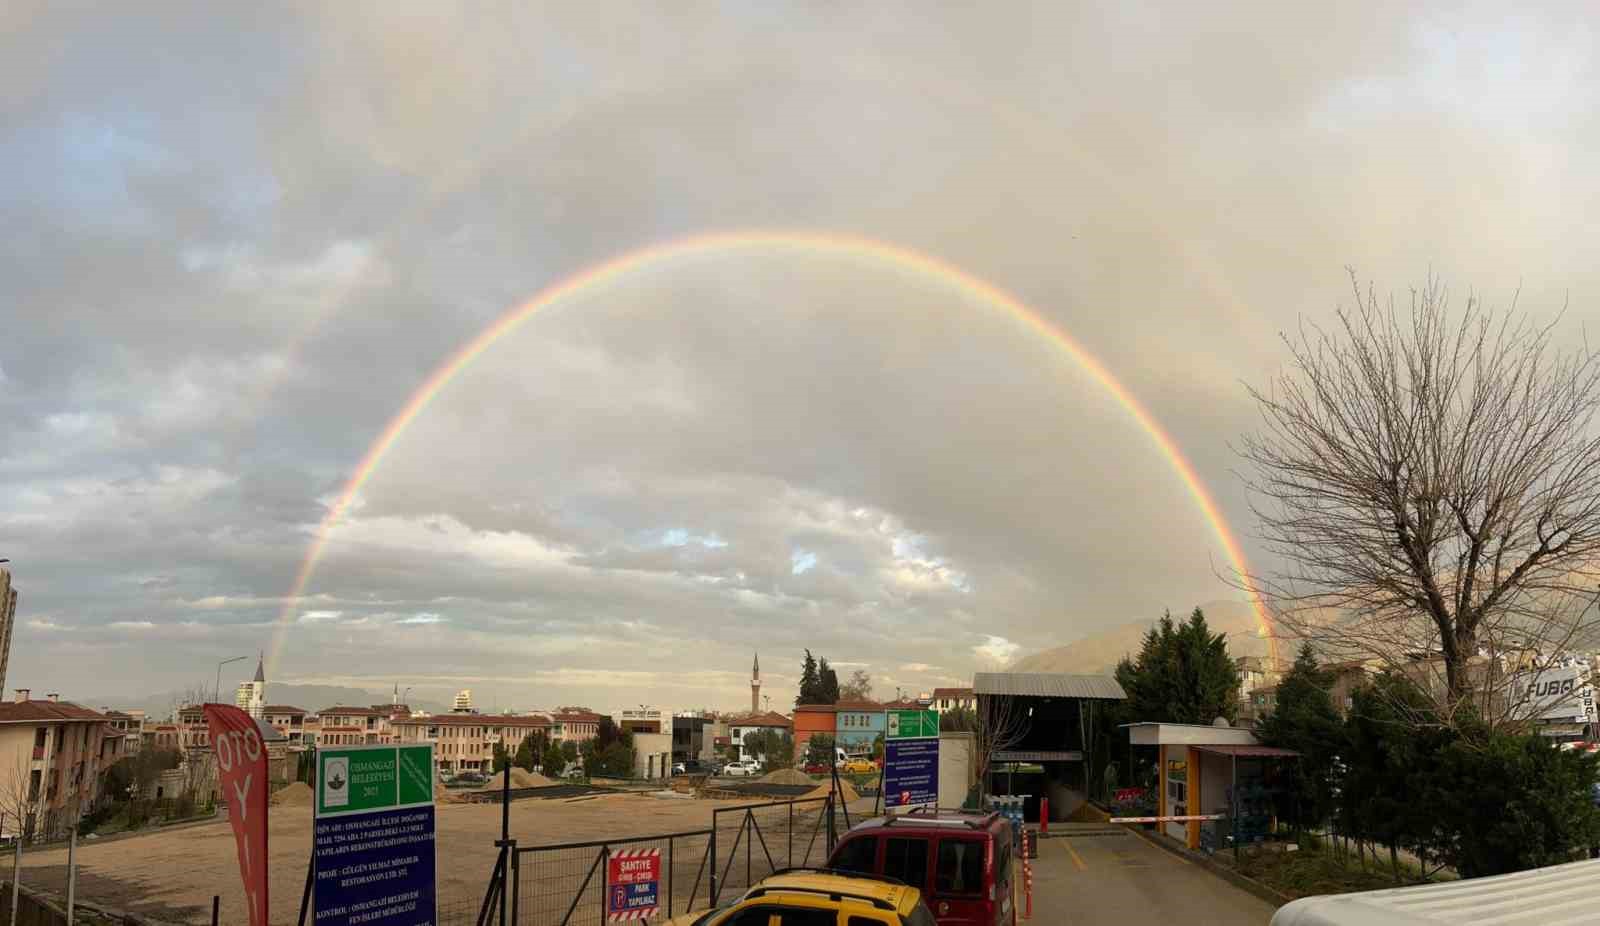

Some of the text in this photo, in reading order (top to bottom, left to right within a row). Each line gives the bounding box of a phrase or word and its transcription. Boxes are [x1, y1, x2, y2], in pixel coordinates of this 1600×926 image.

[1528, 679, 1574, 697] FUBA
[216, 727, 261, 771] OTO
[621, 860, 651, 873] ŞANTİYE
[628, 895, 655, 907] YAPILMAZ
